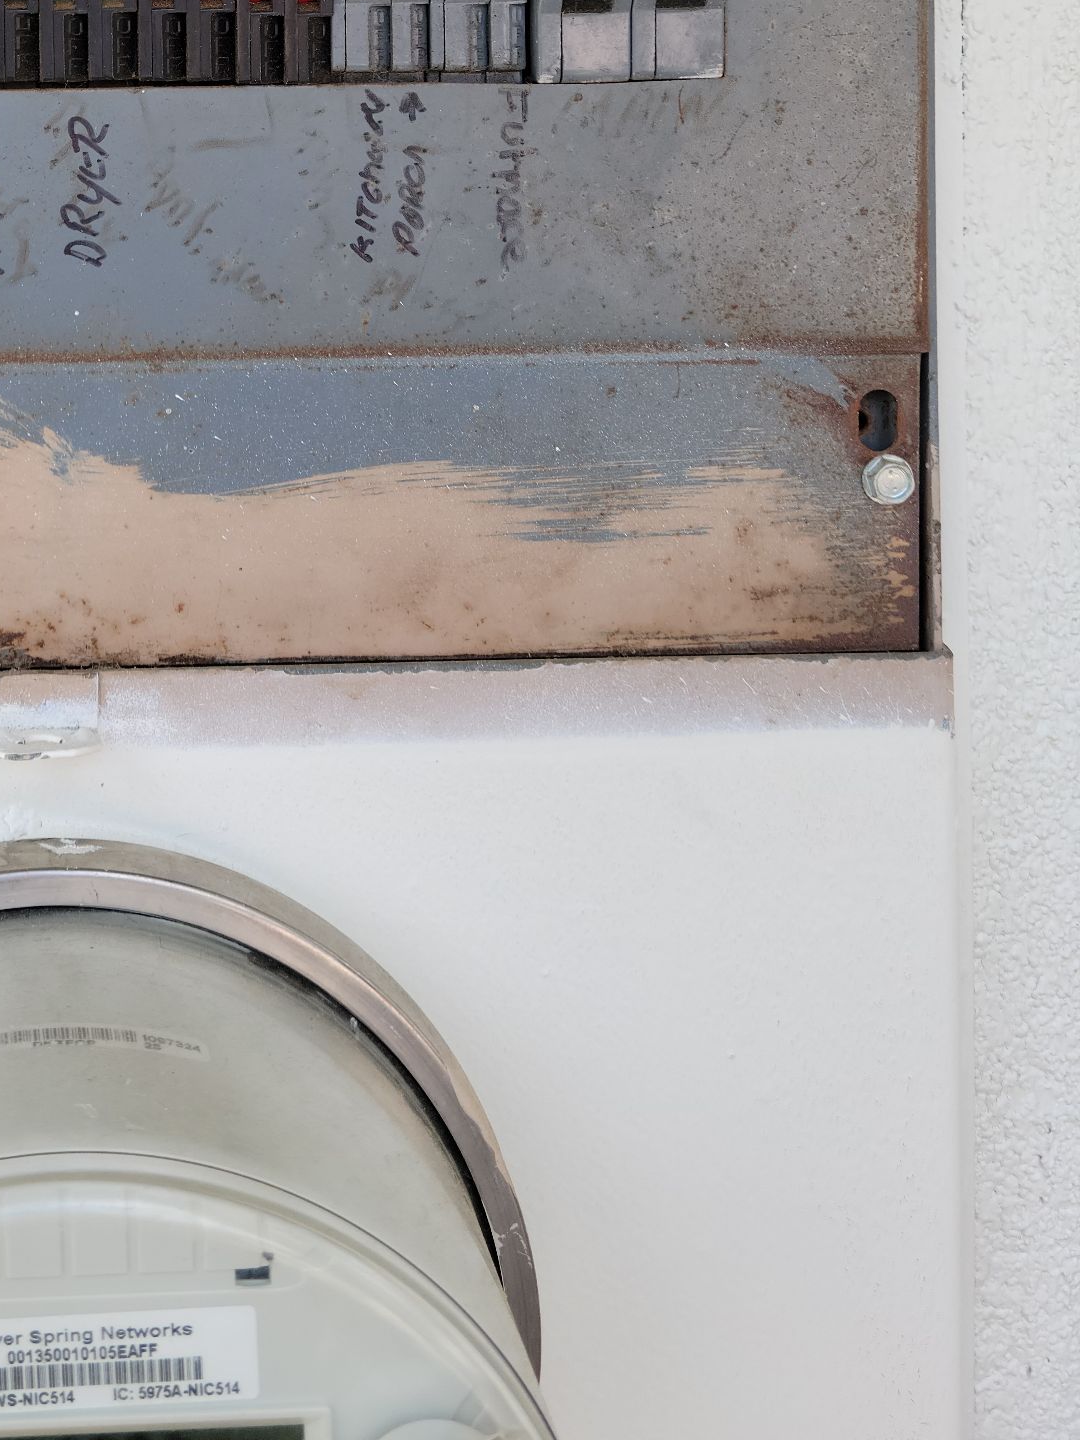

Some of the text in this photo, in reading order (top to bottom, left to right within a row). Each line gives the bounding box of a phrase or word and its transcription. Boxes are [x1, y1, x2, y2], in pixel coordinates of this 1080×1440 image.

[29, 1328, 93, 1346] Spring
[101, 1323, 193, 1340] Networks
[7, 1343, 157, 1364] 001350010105EAFF
[113, 1389, 134, 1401] IC:
[138, 1382, 240, 1400] 5975A-NIC514
